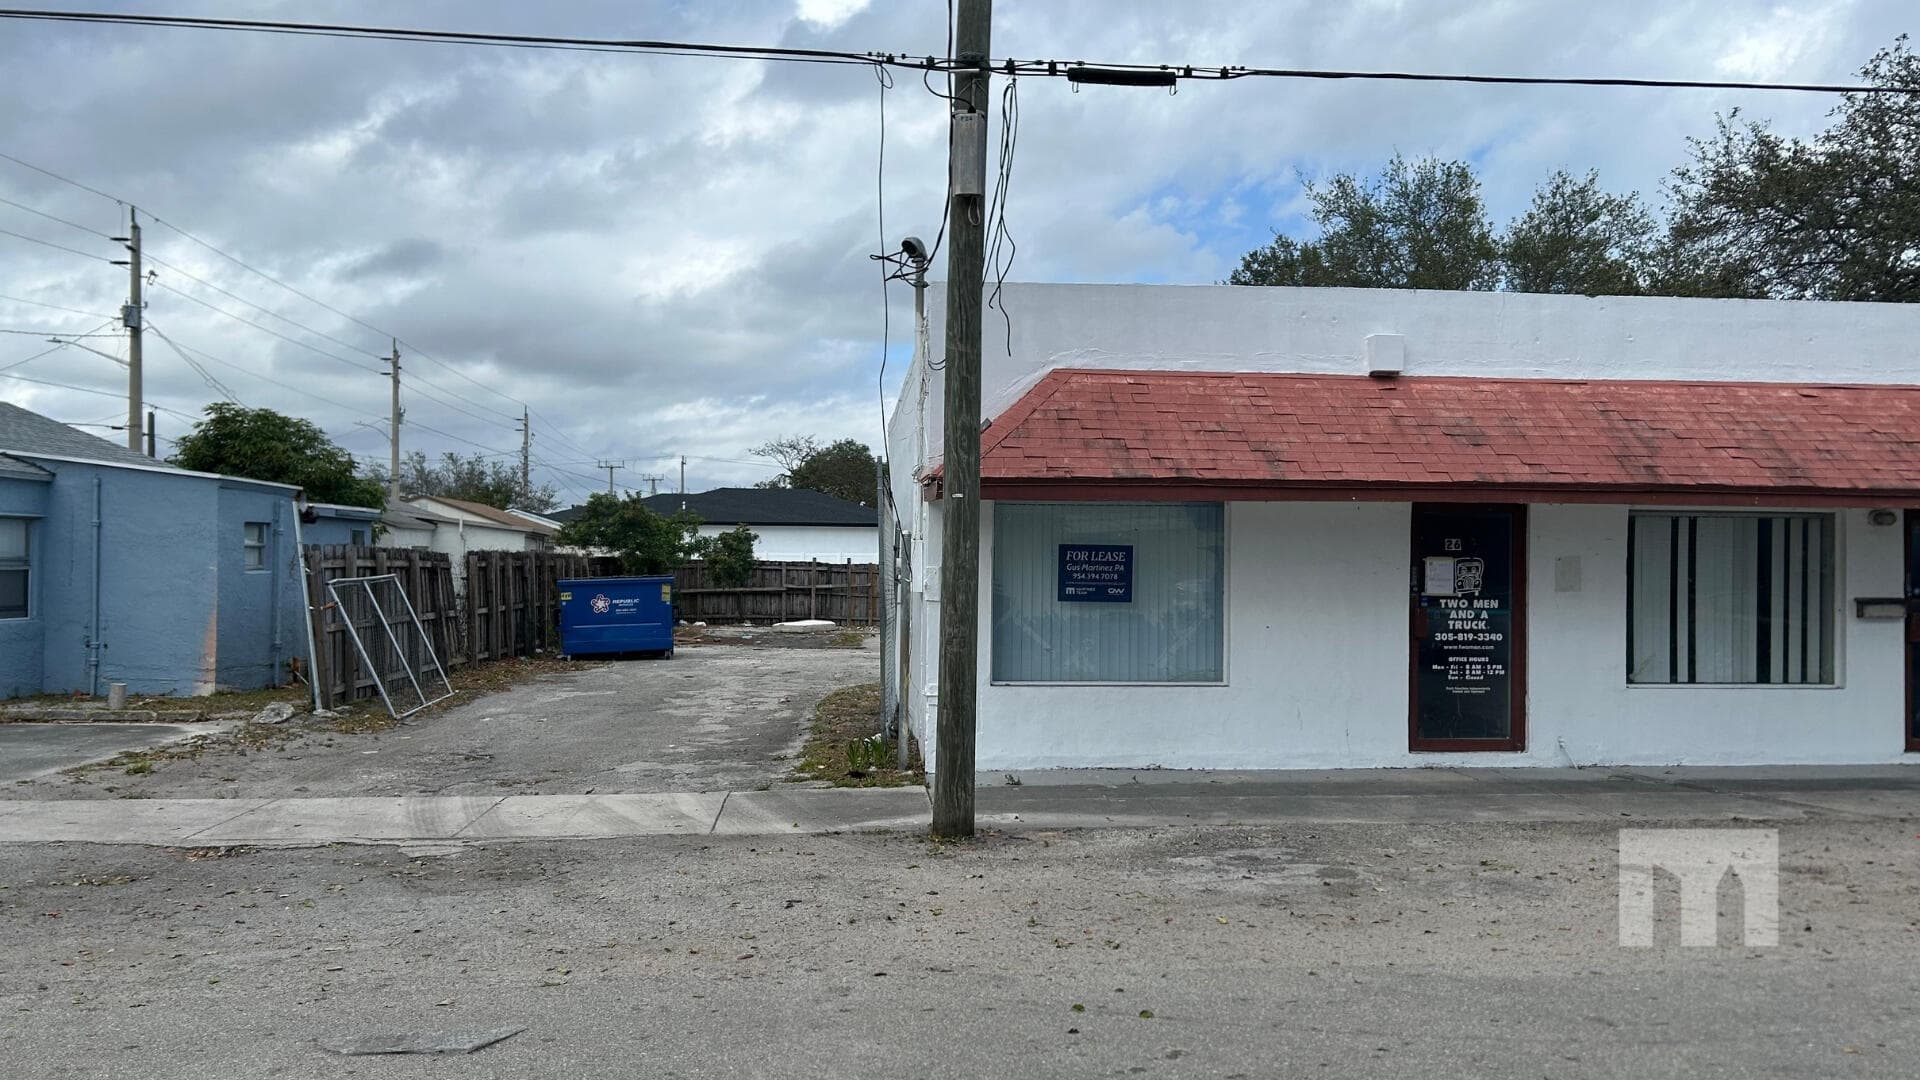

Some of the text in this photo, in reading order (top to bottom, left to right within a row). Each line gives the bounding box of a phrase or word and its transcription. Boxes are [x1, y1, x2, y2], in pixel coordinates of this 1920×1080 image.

[1446, 540, 1460, 550] 26
[1066, 551, 1126, 562] FOR LEASE
[1066, 563, 1124, 572] Gus Martinez PA
[1440, 599, 1499, 608] TWO MEN
[1449, 610, 1489, 619] AND A
[1434, 632, 1503, 641] 305-819-3340
